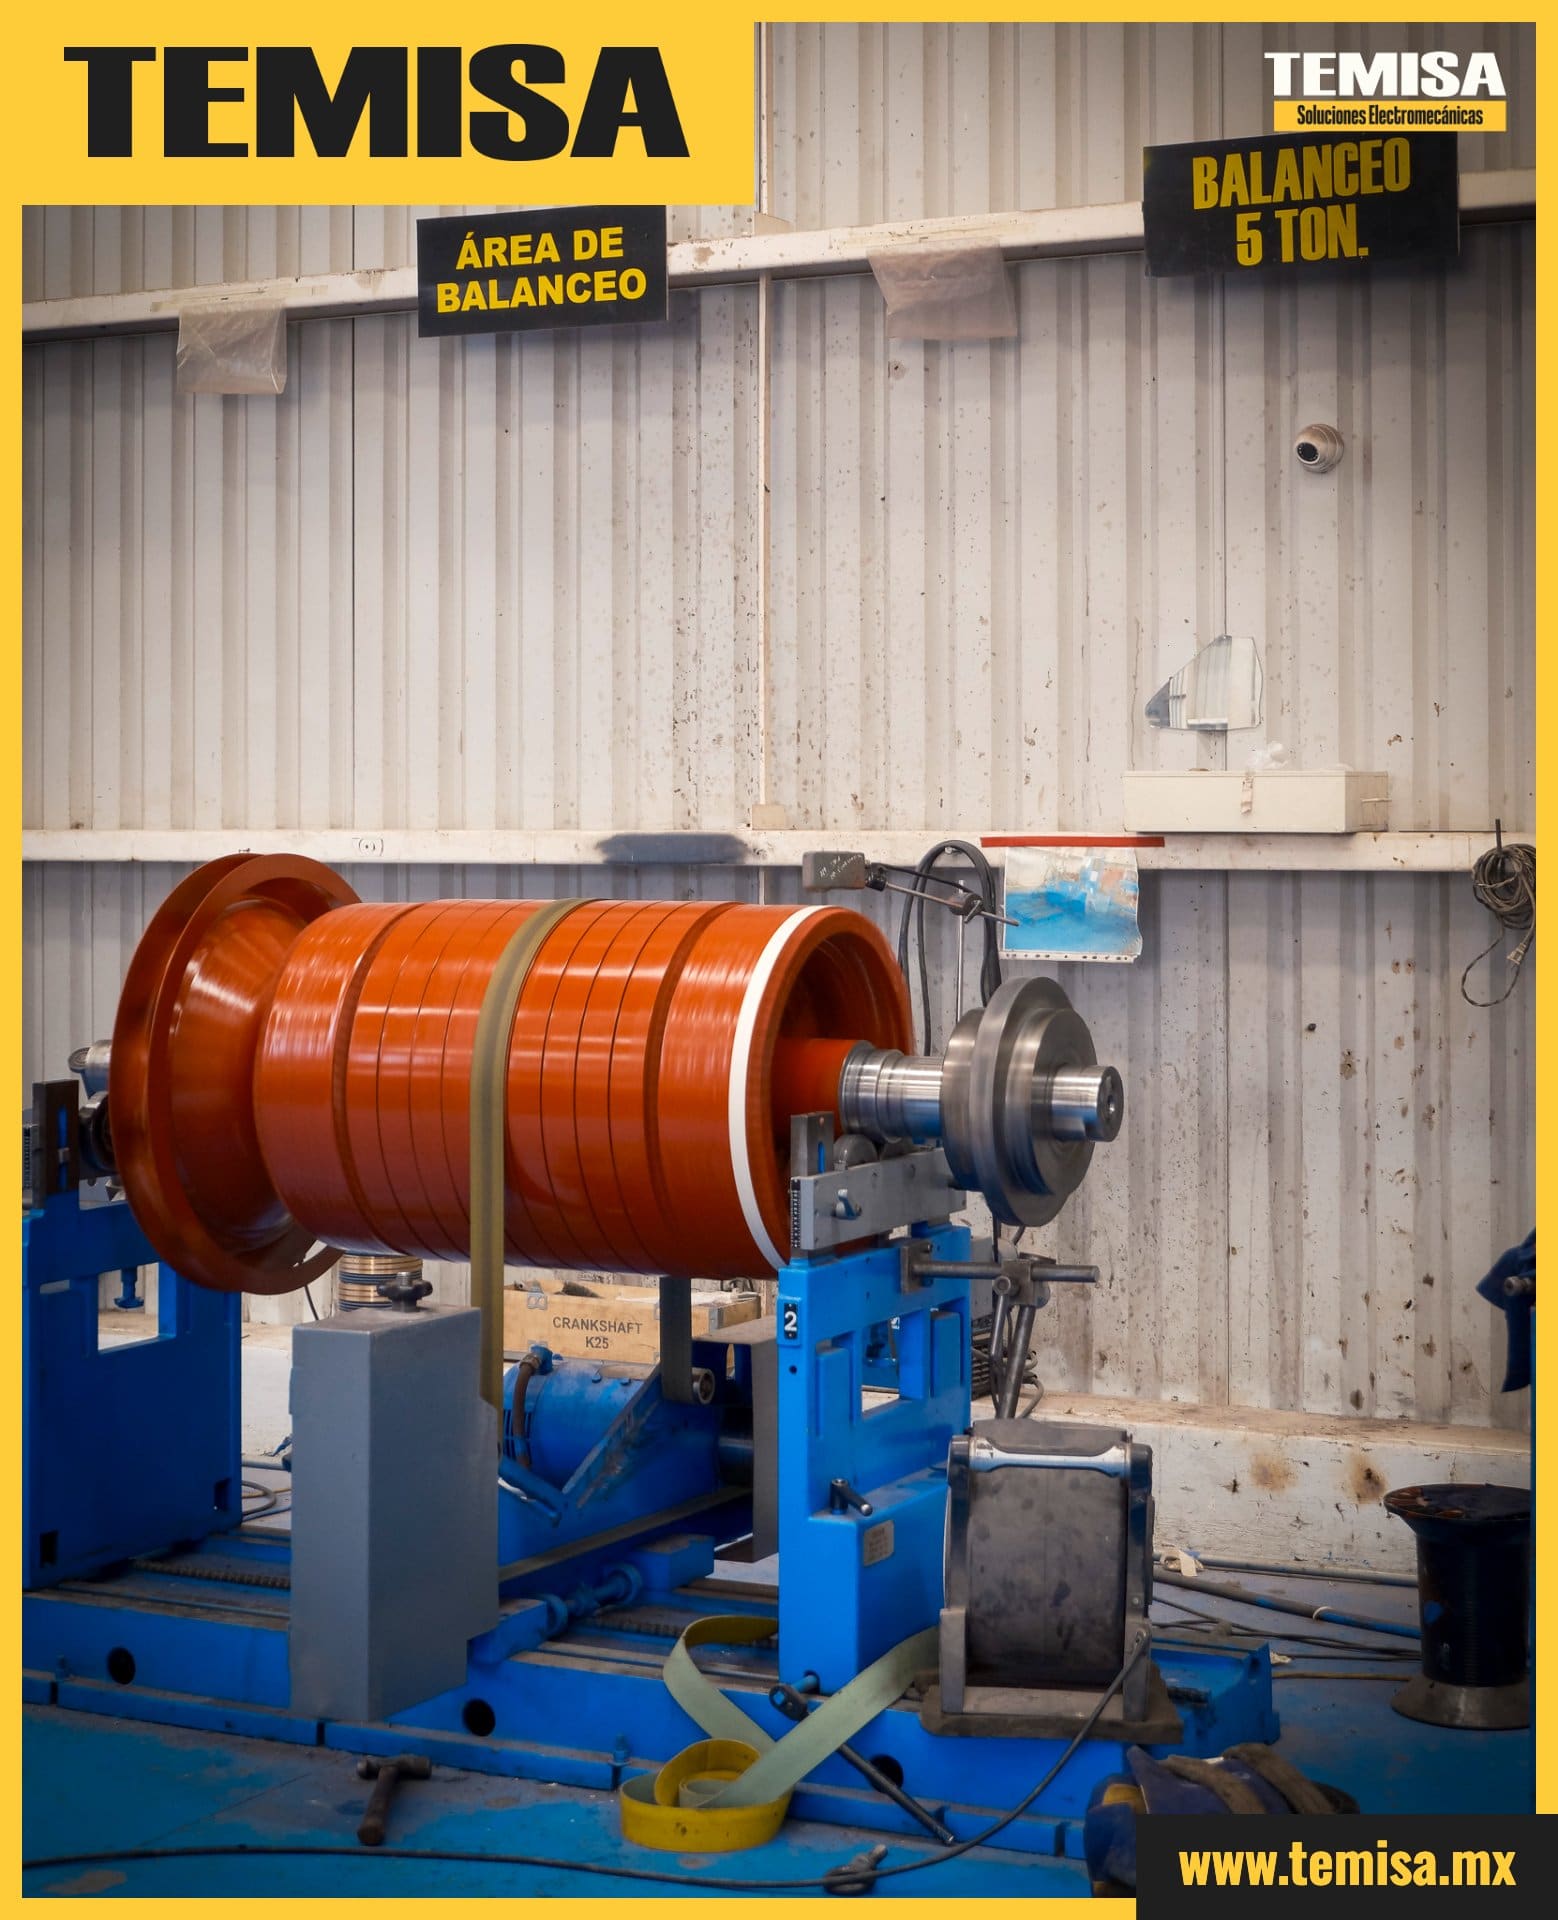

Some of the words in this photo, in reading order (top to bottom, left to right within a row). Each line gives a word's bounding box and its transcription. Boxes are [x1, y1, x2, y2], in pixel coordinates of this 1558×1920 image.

[1192, 137, 1411, 210] BALANCEO
[455, 230, 561, 271] ÁREA
[573, 226, 625, 262] DE
[1235, 211, 1263, 267] 5
[1275, 203, 1369, 263] TON.
[436, 267, 648, 314] BALANCEO
[552, 1315, 643, 1335] CRANKSHAFT
[585, 1335, 609, 1350] K25
[784, 1310, 797, 1332] 2
